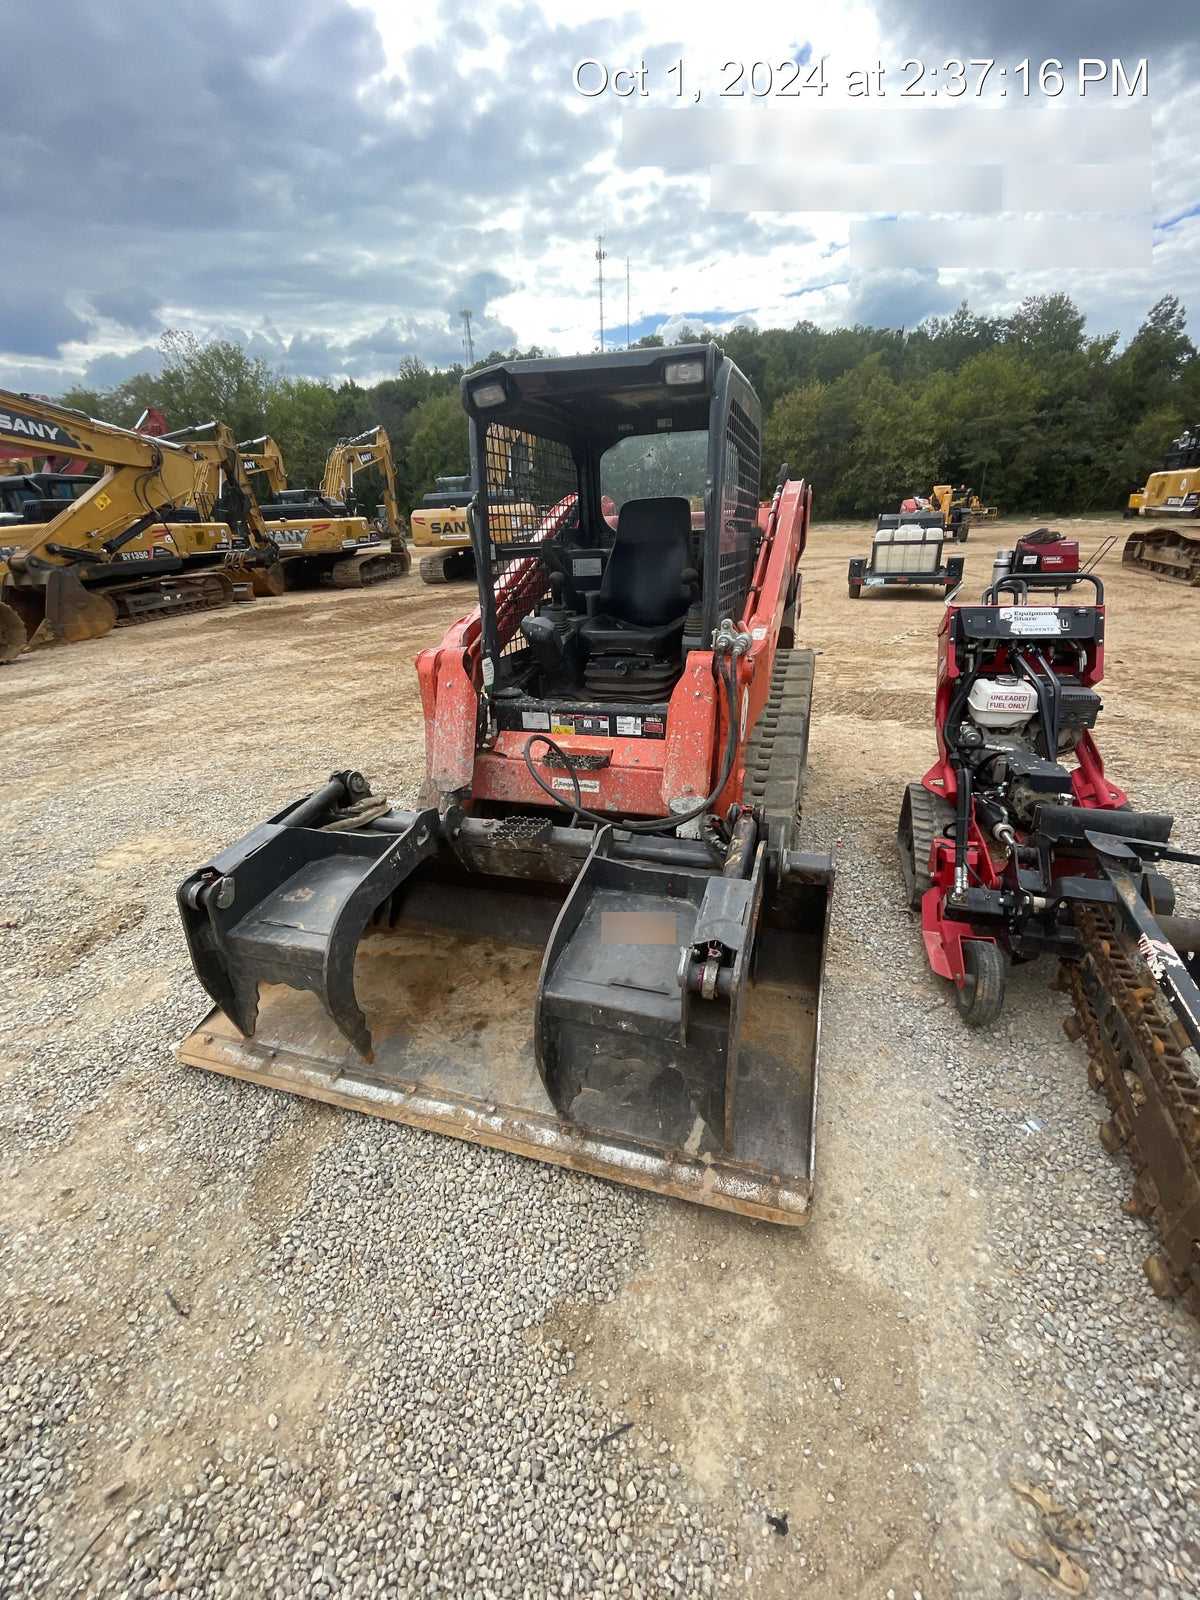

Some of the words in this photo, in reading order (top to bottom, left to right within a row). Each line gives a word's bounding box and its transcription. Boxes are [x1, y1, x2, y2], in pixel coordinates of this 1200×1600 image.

[0, 413, 59, 440] SANY
[244, 461, 256, 469] ANY
[430, 521, 468, 534] SAN
[990, 694, 1028, 702] UNLEADED
